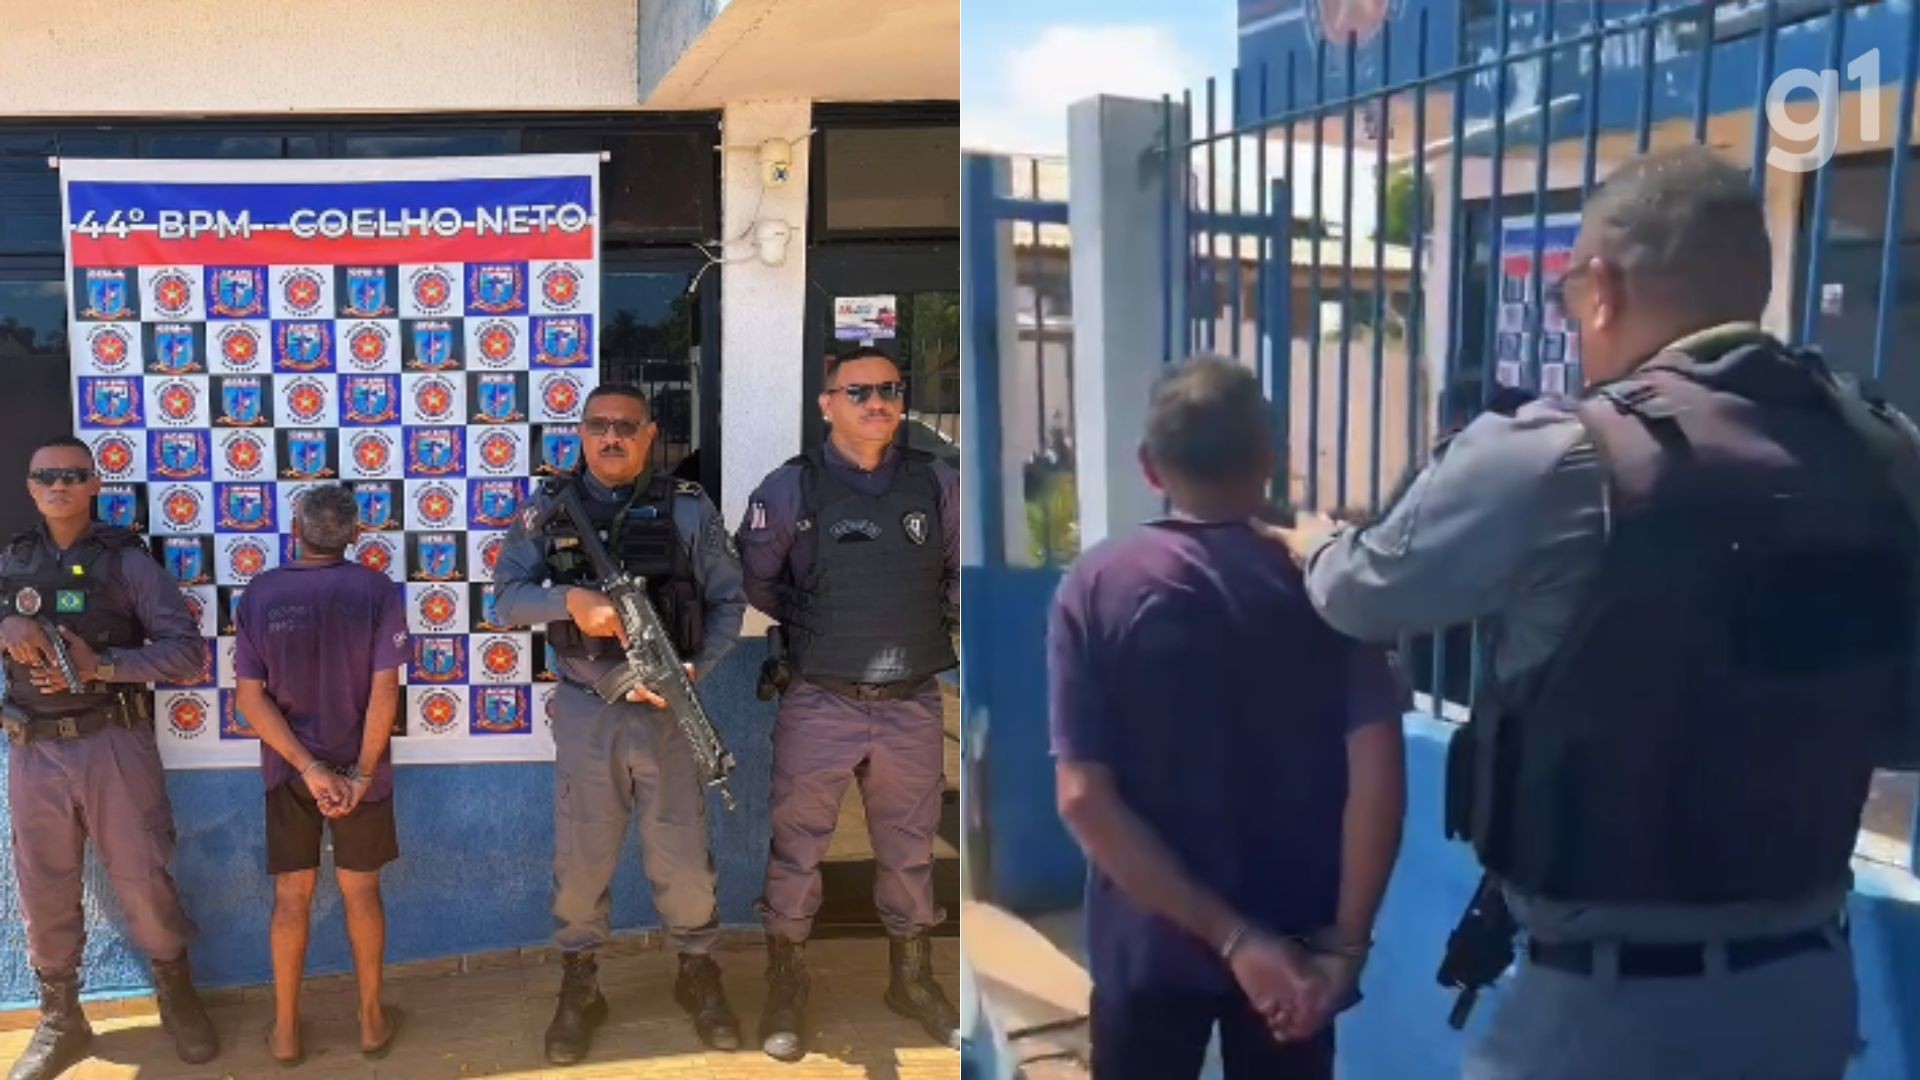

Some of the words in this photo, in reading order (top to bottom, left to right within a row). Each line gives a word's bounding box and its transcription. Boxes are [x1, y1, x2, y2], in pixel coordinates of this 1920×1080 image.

[159, 210, 250, 239] BPM
[289, 208, 462, 238] COELHO
[476, 203, 587, 236] NETO
